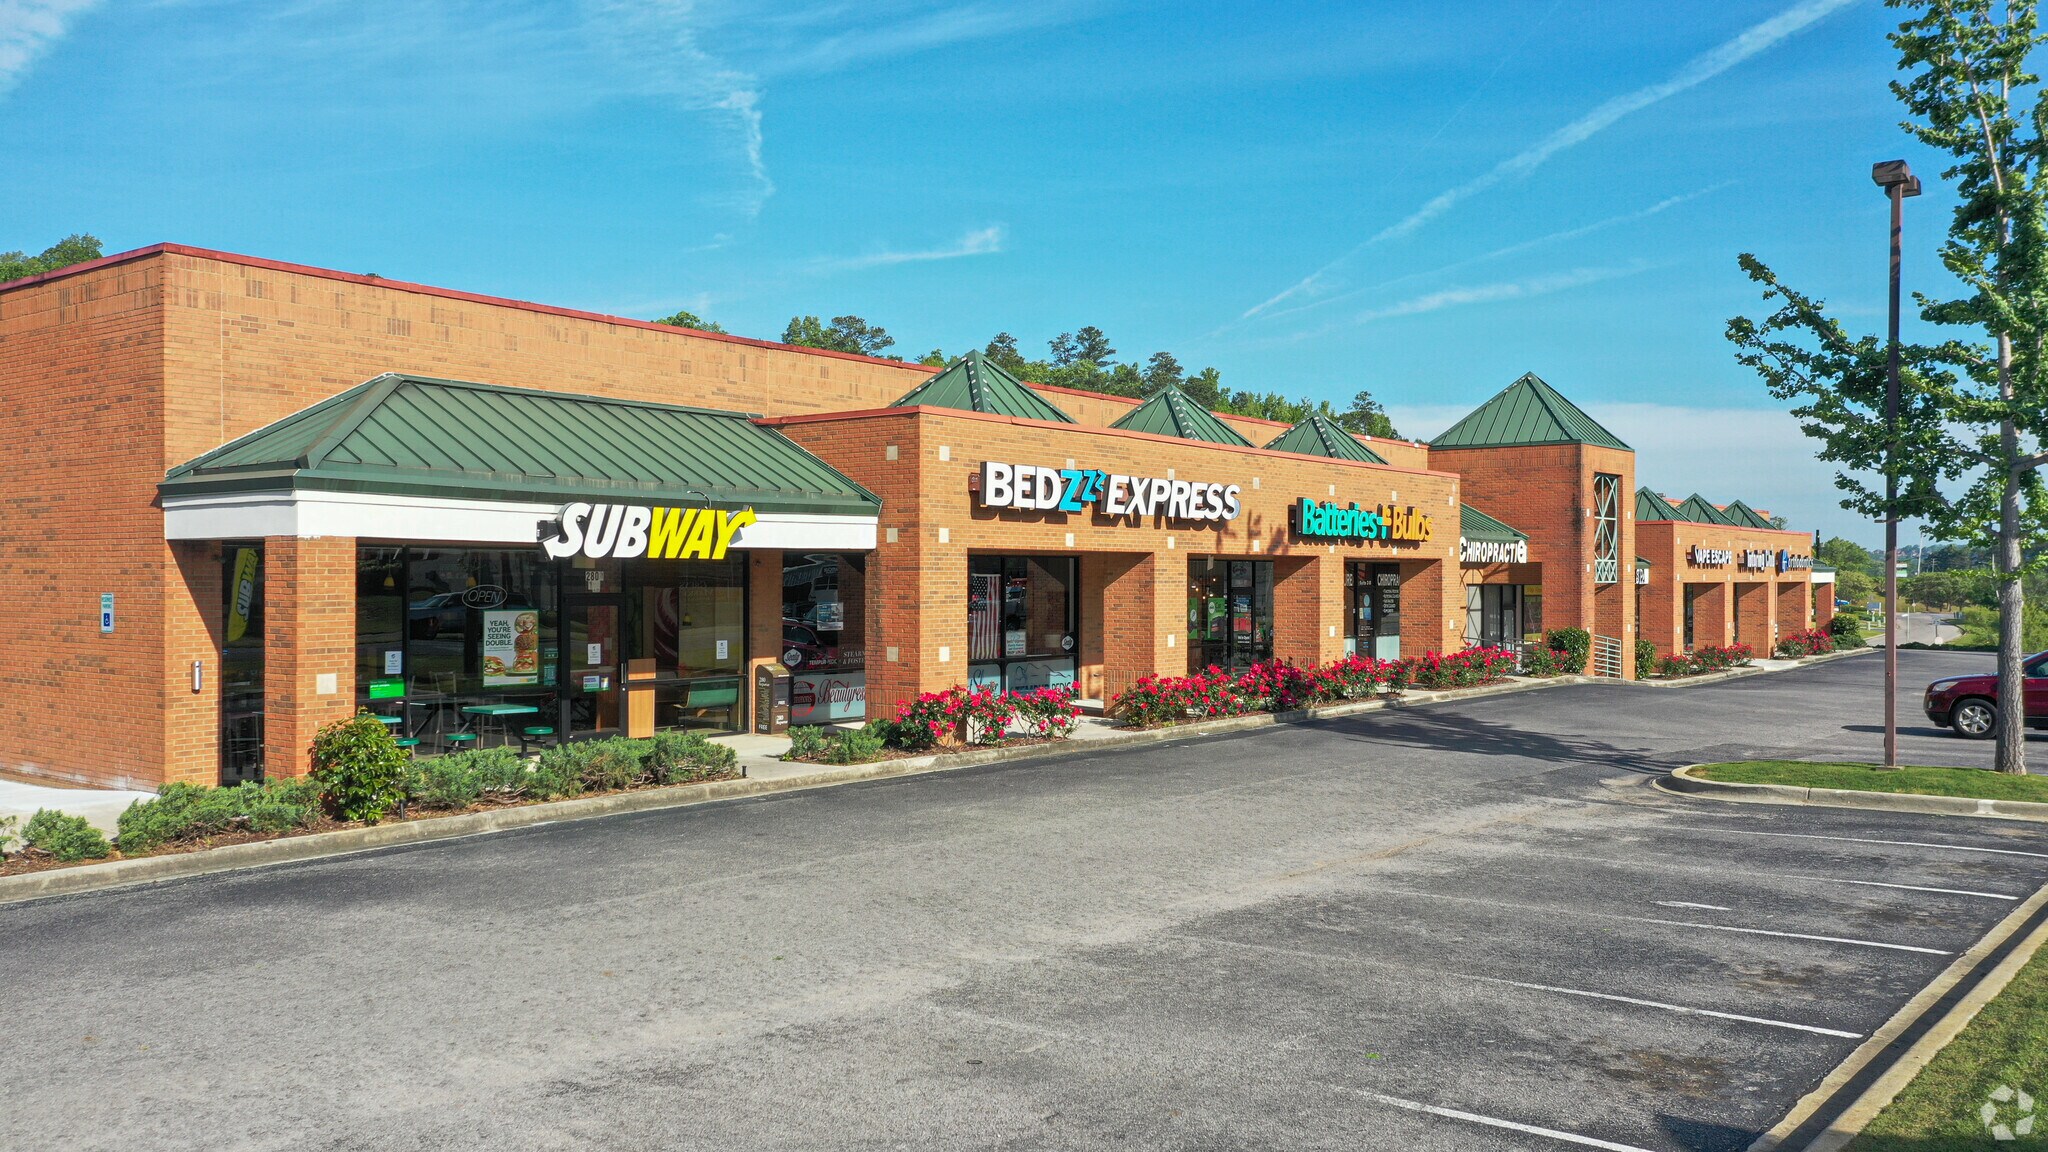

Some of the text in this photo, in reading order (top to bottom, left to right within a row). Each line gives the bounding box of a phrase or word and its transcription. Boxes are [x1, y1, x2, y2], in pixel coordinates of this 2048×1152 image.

[1107, 474, 1241, 520] EXPRESS
[543, 502, 757, 561] SUBWAY
[1303, 498, 1377, 538] Batteries
[1392, 507, 1433, 541] Bulbs
[1695, 549, 1732, 564] VAPE ESCAPE
[237, 548, 258, 621] SUBWAY
[468, 590, 501, 603] OPEN
